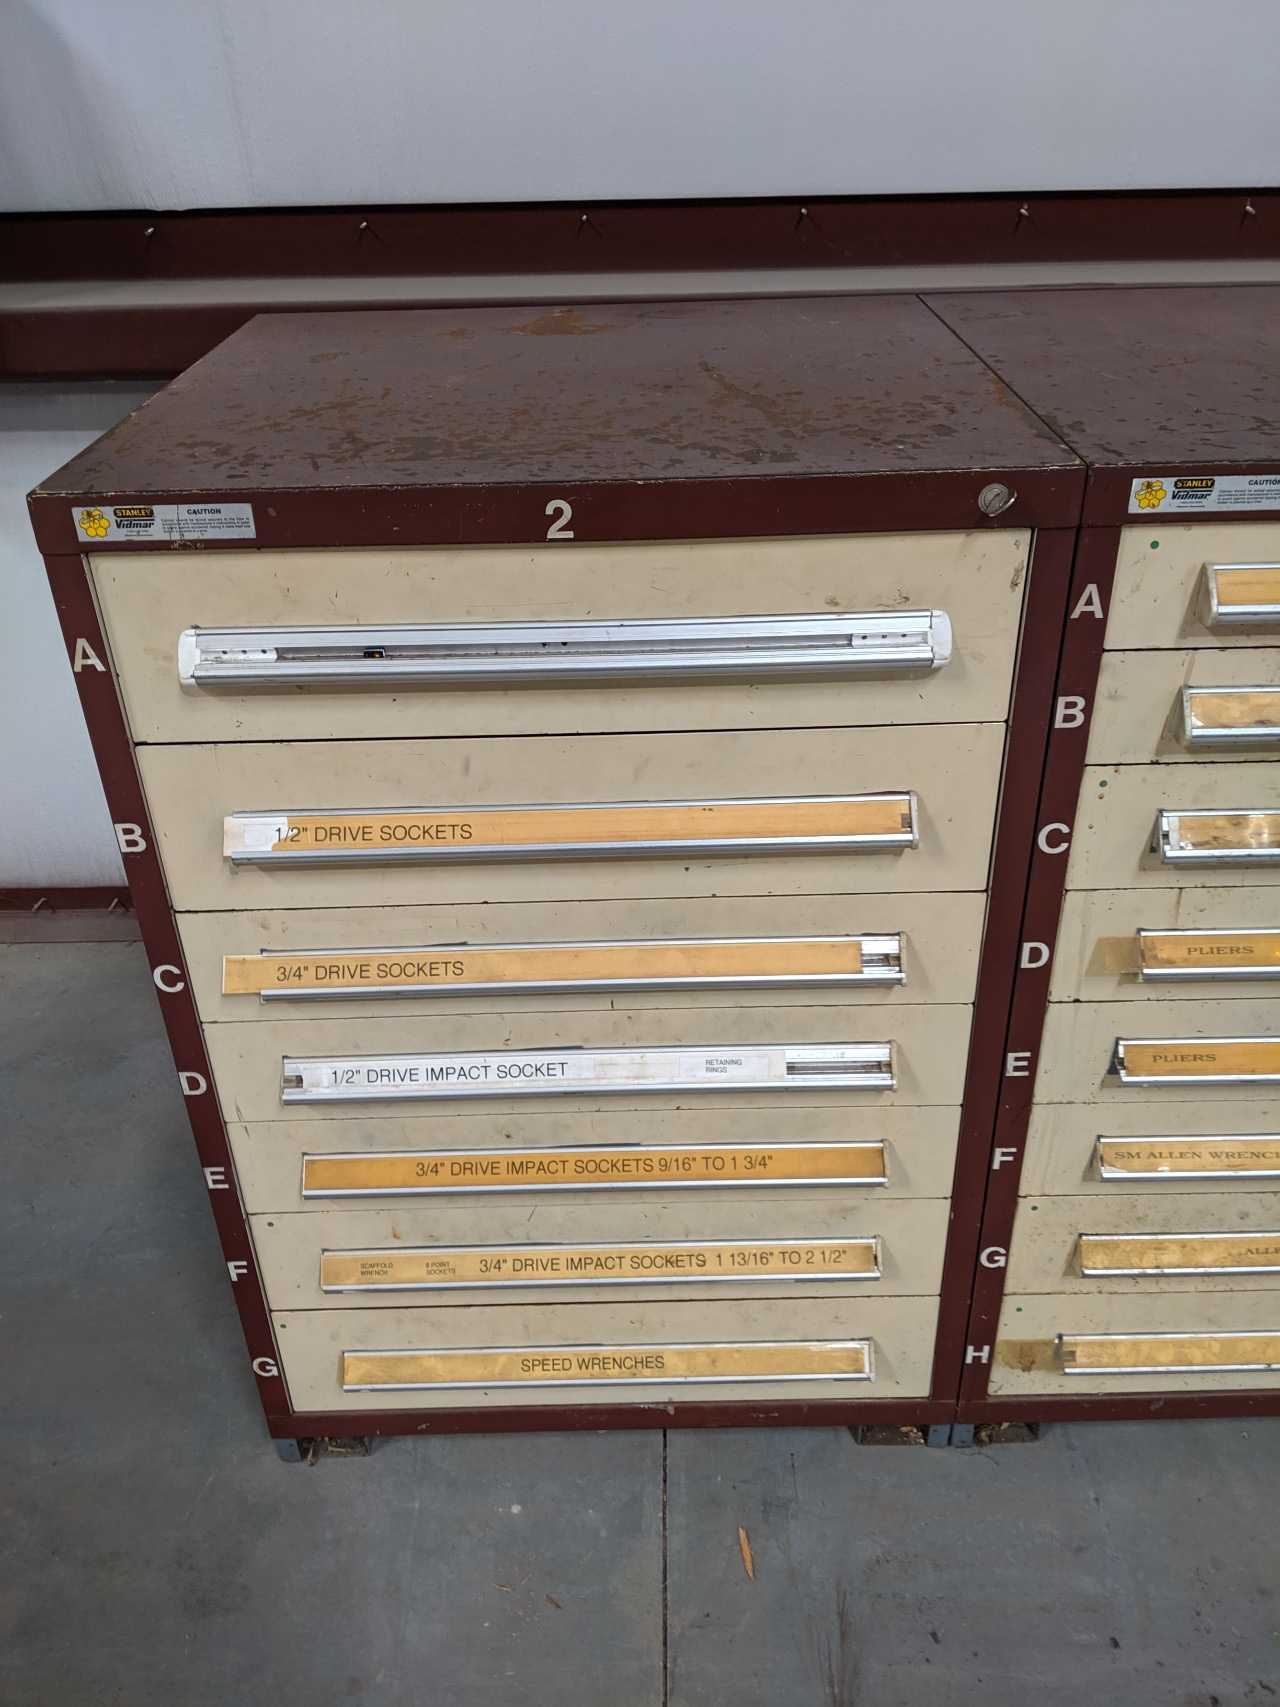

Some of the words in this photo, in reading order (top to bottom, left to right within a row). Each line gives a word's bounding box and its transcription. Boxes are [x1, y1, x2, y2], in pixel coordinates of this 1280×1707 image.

[1175, 479, 1213, 488] STANLEY
[1171, 490, 1211, 500] Vidmar
[115, 508, 154, 517] STANLEY
[546, 500, 573, 538] 2
[115, 519, 154, 529] Vidmar
[1071, 584, 1102, 618] A
[74, 639, 105, 671] A
[1055, 696, 1085, 728] B
[115, 824, 146, 852] B
[275, 826, 308, 843] 1/2"
[314, 825, 374, 842] DRIVE
[379, 824, 473, 840] SOCKETS
[1039, 823, 1069, 853] C
[1021, 943, 1049, 968] D
[1187, 945, 1255, 955] PLIERS
[154, 965, 184, 992] C
[276, 965, 309, 982] 3/4"
[315, 963, 371, 980] DRIVE
[376, 961, 465, 978] SOCKETS
[705, 1058, 743, 1066] RETAINING
[1006, 1053, 1030, 1076] E
[1152, 1053, 1217, 1063] PLIERS
[179, 1072, 206, 1094] D
[331, 1069, 361, 1084] 1/2"
[367, 1067, 419, 1084] DRIVE
[425, 1065, 491, 1081] IMPACT
[496, 1062, 569, 1079] SOCKET
[416, 1161, 445, 1177] 3/4"
[450, 1161, 501, 1176] DRIVE
[506, 1159, 569, 1175] IMPACT
[574, 1158, 654, 1174] SOCKETS
[658, 1156, 697, 1172] 9/16"
[701, 1156, 725, 1171] TO
[730, 1155, 737, 1170] 1
[744, 1154, 773, 1170] 3/4"
[993, 1148, 1016, 1169] F
[1114, 1151, 1142, 1160] SM
[1146, 1151, 1202, 1160] ALLEN
[205, 1168, 228, 1188] E
[479, 1258, 508, 1273] 3/4"
[512, 1257, 560, 1272] DRIVE
[566, 1255, 625, 1270] IMPACT
[630, 1253, 706, 1270] SOCKETS
[716, 1253, 722, 1266] 1
[730, 1252, 774, 1267] 13/16"
[778, 1250, 801, 1265] TO
[805, 1250, 814, 1264] 2
[822, 1249, 847, 1264] 1/2"
[981, 1247, 1006, 1267] G
[228, 1262, 247, 1281] F
[521, 1358, 573, 1372] SPEED
[576, 1355, 665, 1371] WRENCHES
[966, 1346, 989, 1363] H
[253, 1358, 278, 1376] G
